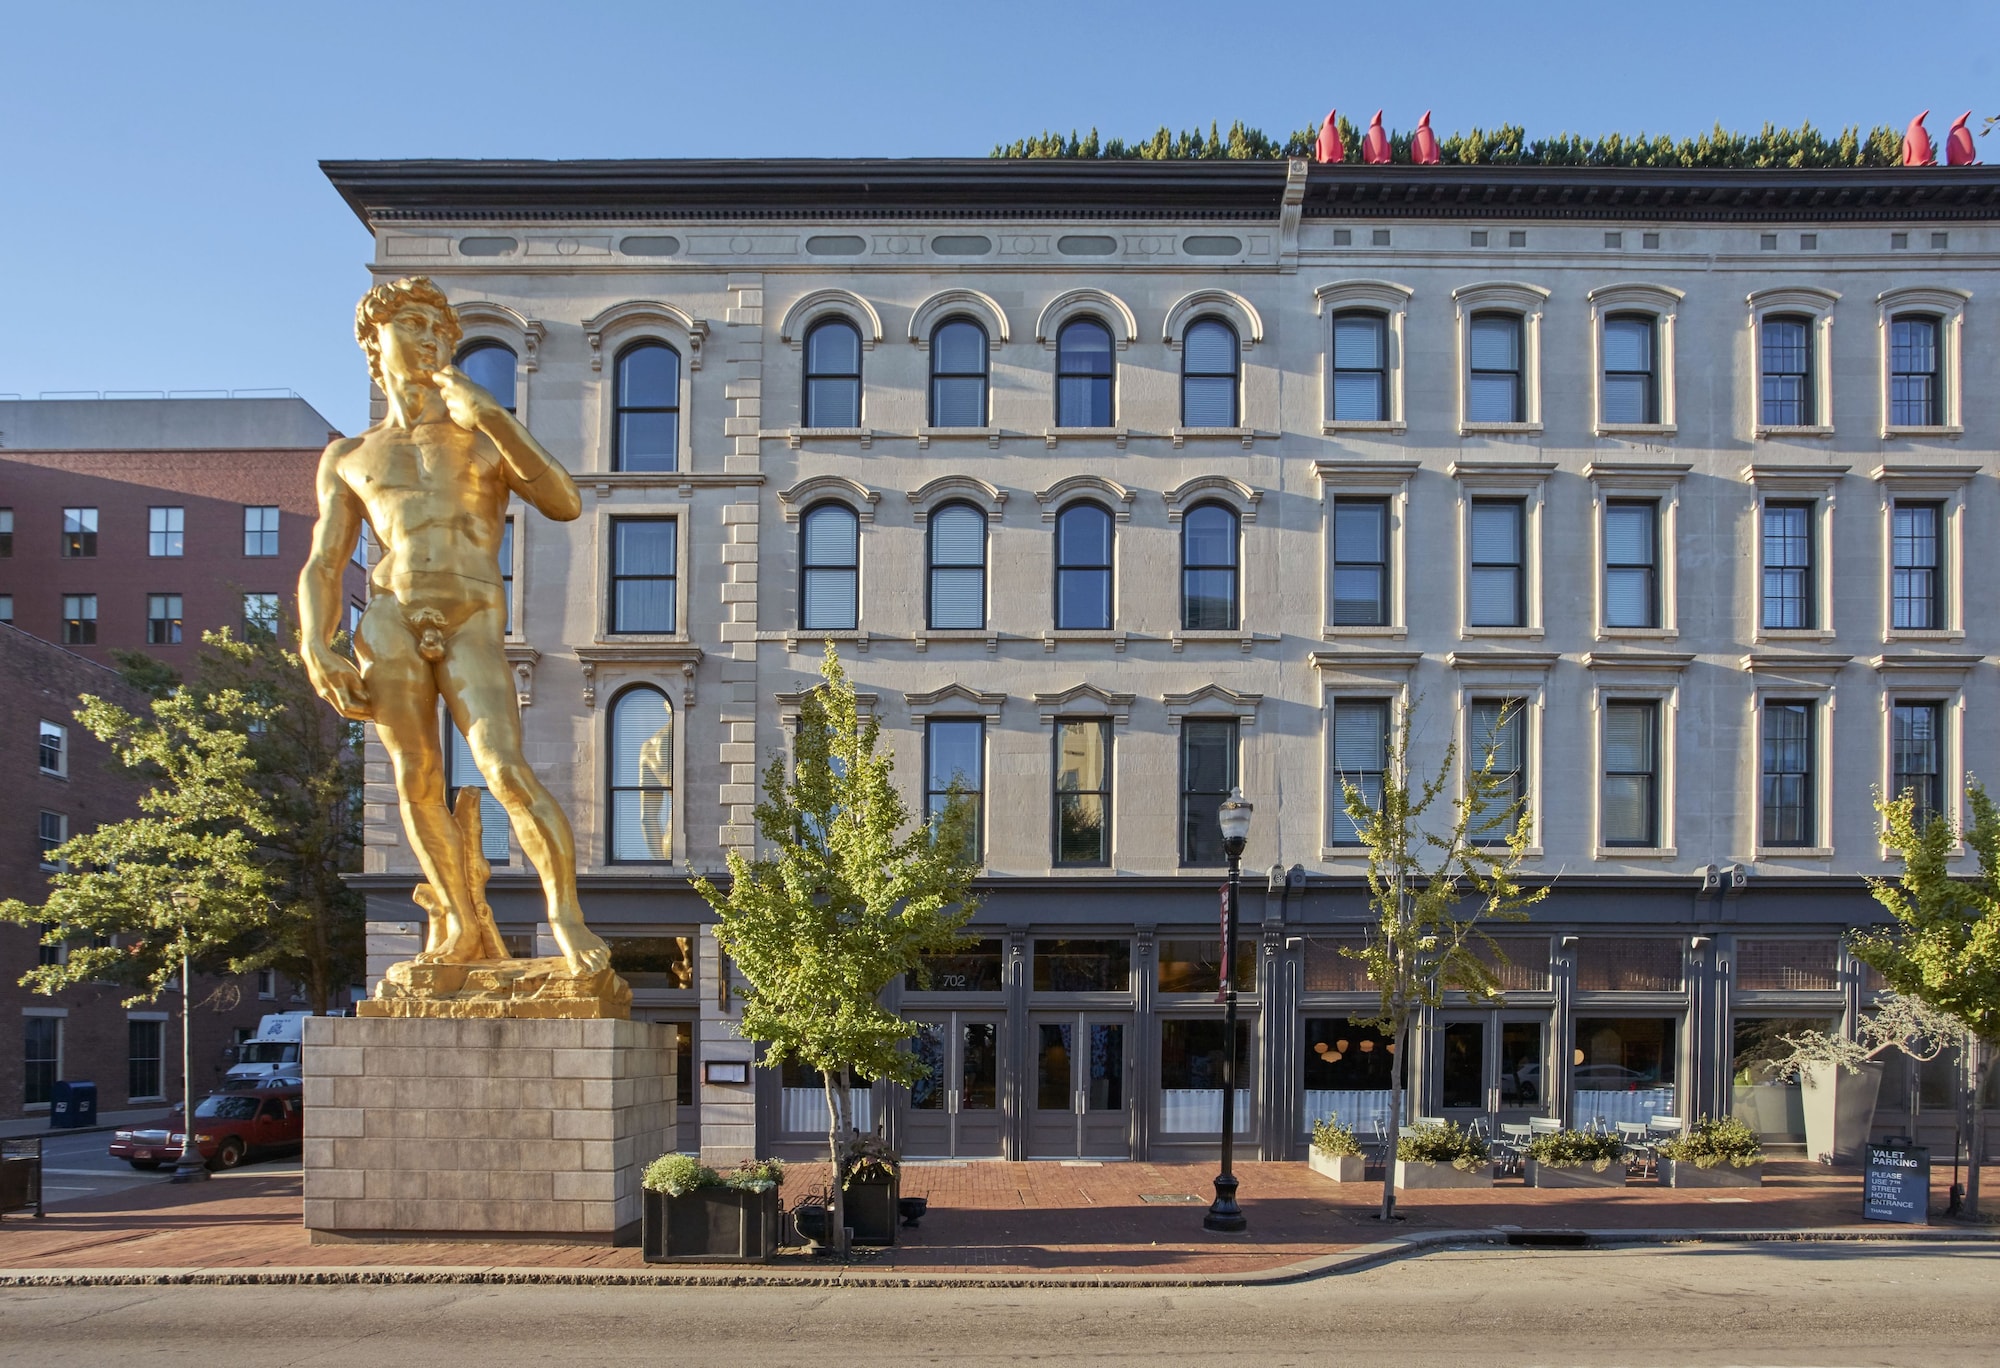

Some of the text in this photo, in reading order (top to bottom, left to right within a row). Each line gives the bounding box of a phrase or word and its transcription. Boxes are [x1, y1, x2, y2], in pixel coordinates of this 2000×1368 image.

[943, 975, 965, 987] 702
[1873, 1150, 1905, 1159] VALET
[1873, 1158, 1918, 1167] PARKING
[1872, 1171, 1902, 1180] PLEASE
[1871, 1185, 1902, 1193] STREET
[1871, 1192, 1897, 1200] HOTEL
[1870, 1199, 1913, 1208] ENTRANCE
